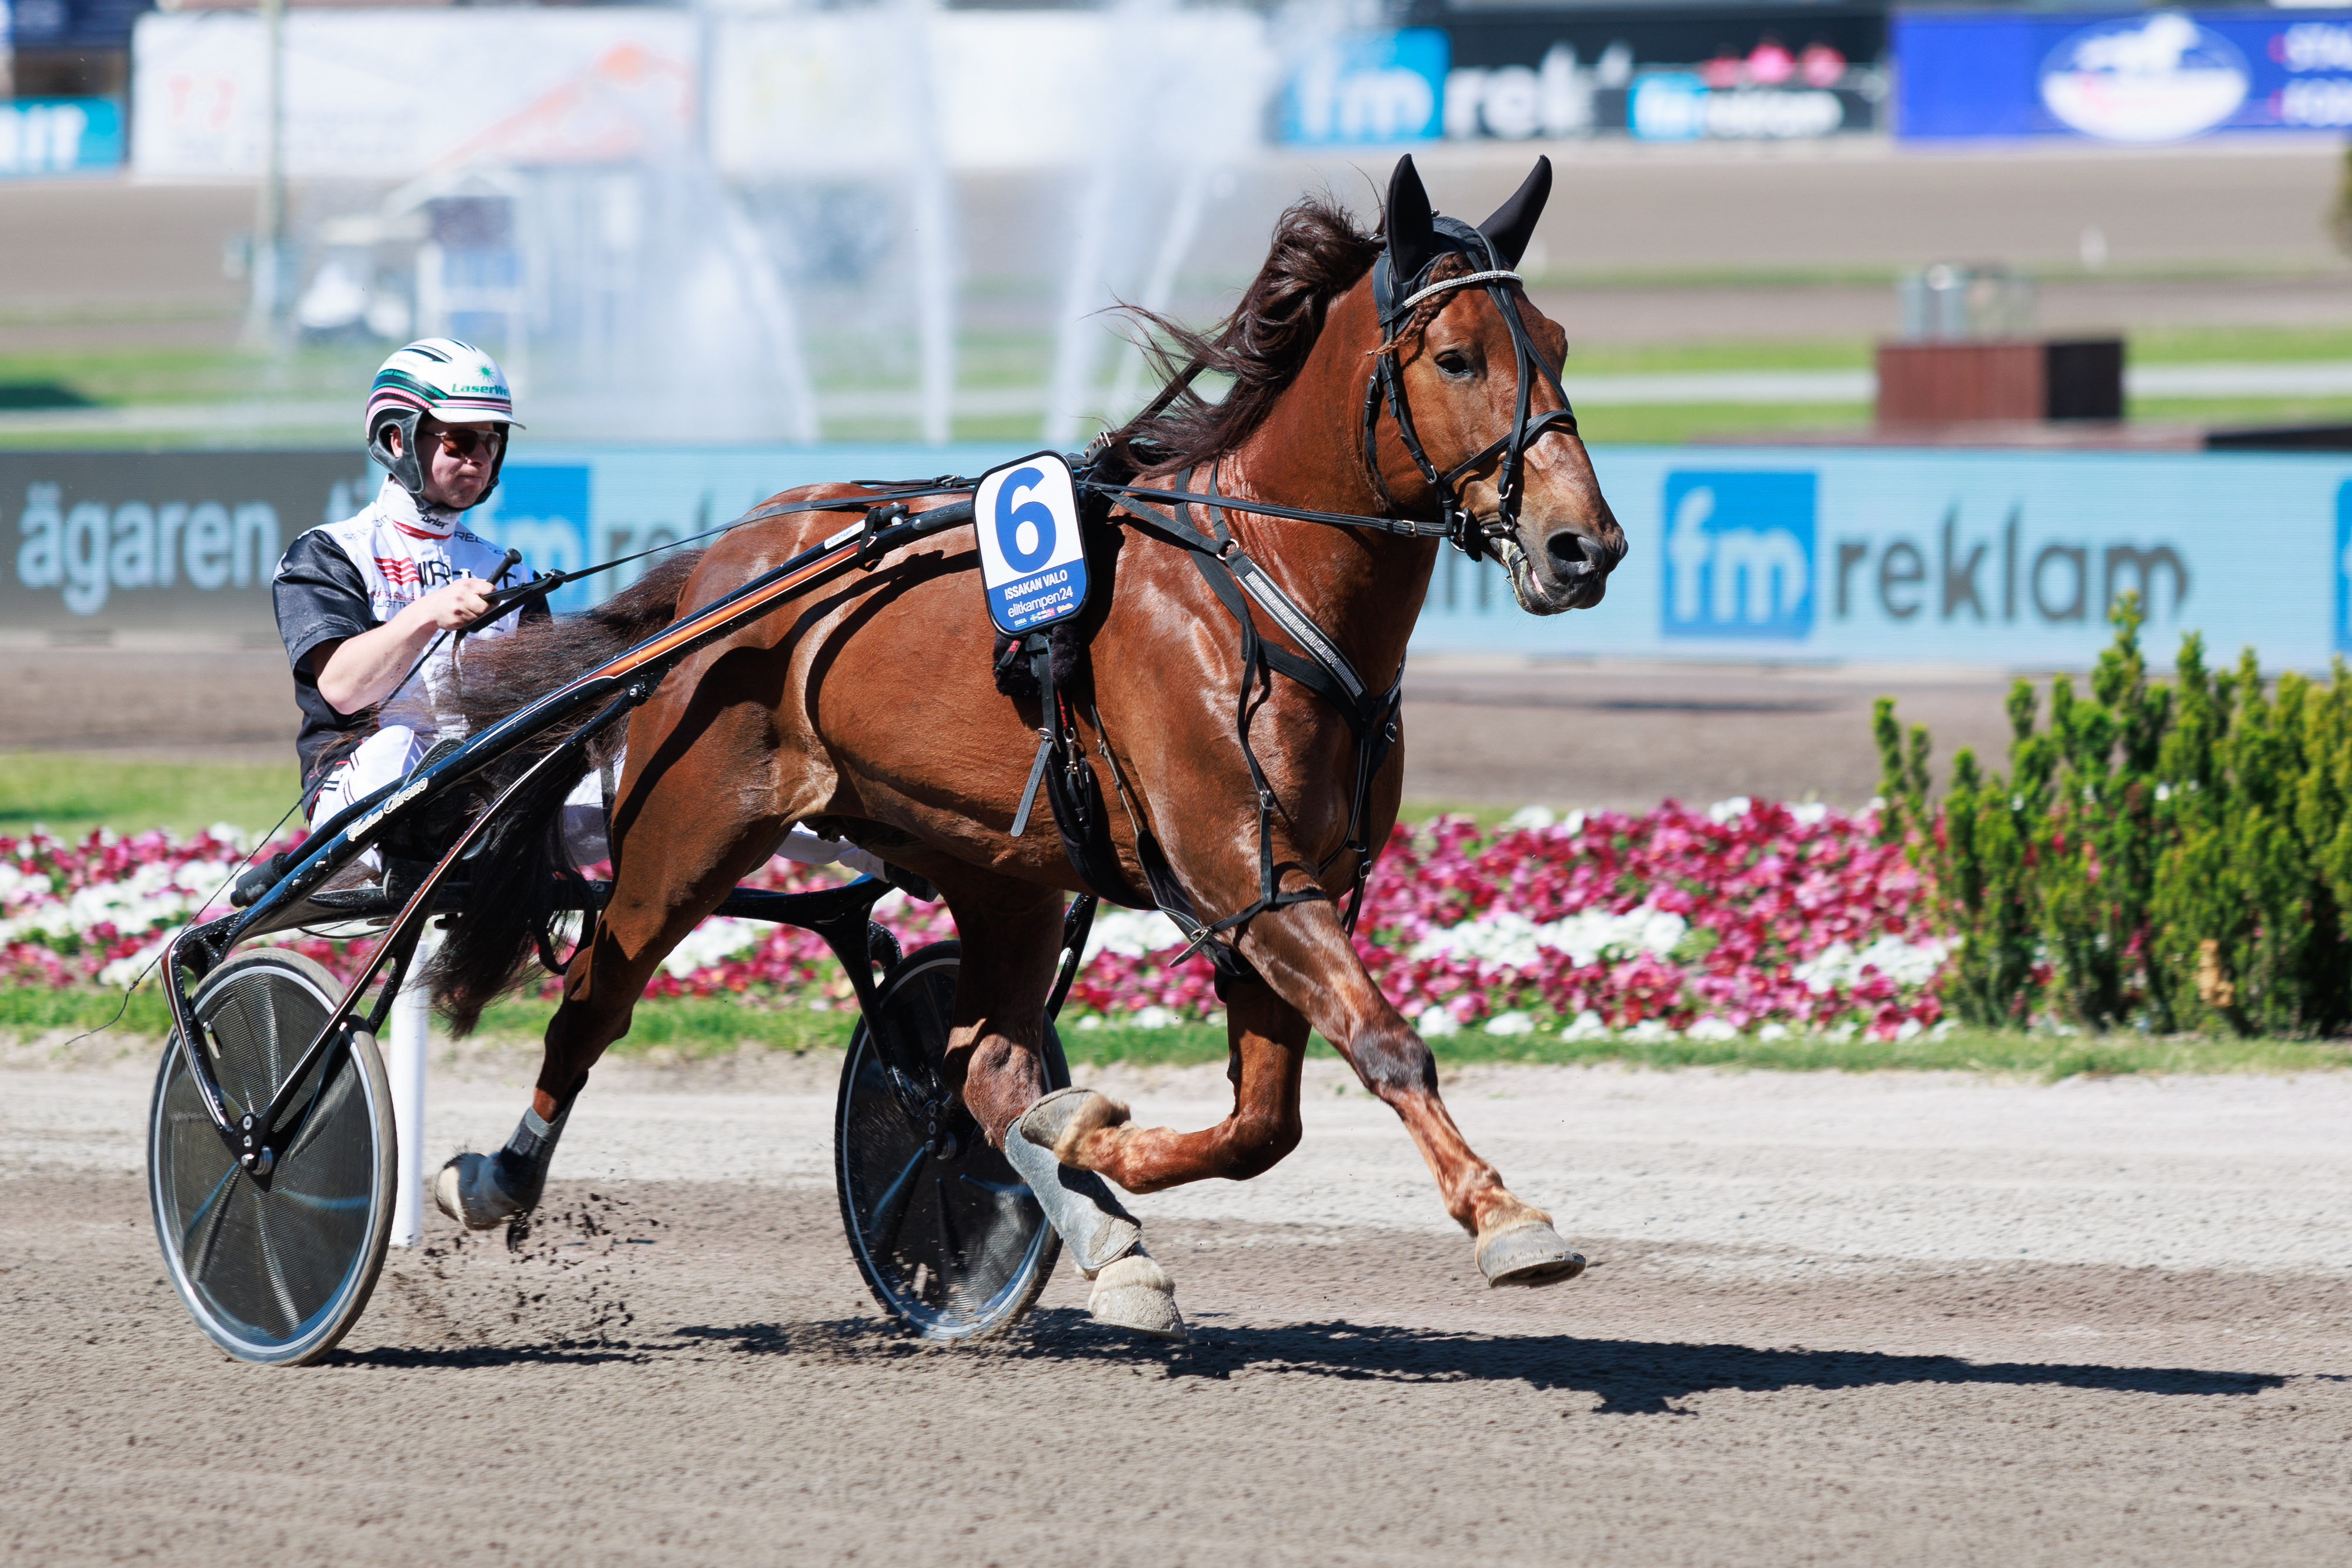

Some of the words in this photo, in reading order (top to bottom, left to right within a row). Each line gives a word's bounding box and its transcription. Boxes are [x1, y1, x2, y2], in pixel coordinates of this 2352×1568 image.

[16, 480, 282, 616] ägaren
[995, 467, 1057, 573] 6
[1668, 484, 1810, 623] fm
[1833, 495, 2196, 623] reklam
[1004, 577, 1043, 600] ISSAKAN
[1042, 569, 1068, 587] VALO
[383, 777, 429, 814] Chrono
